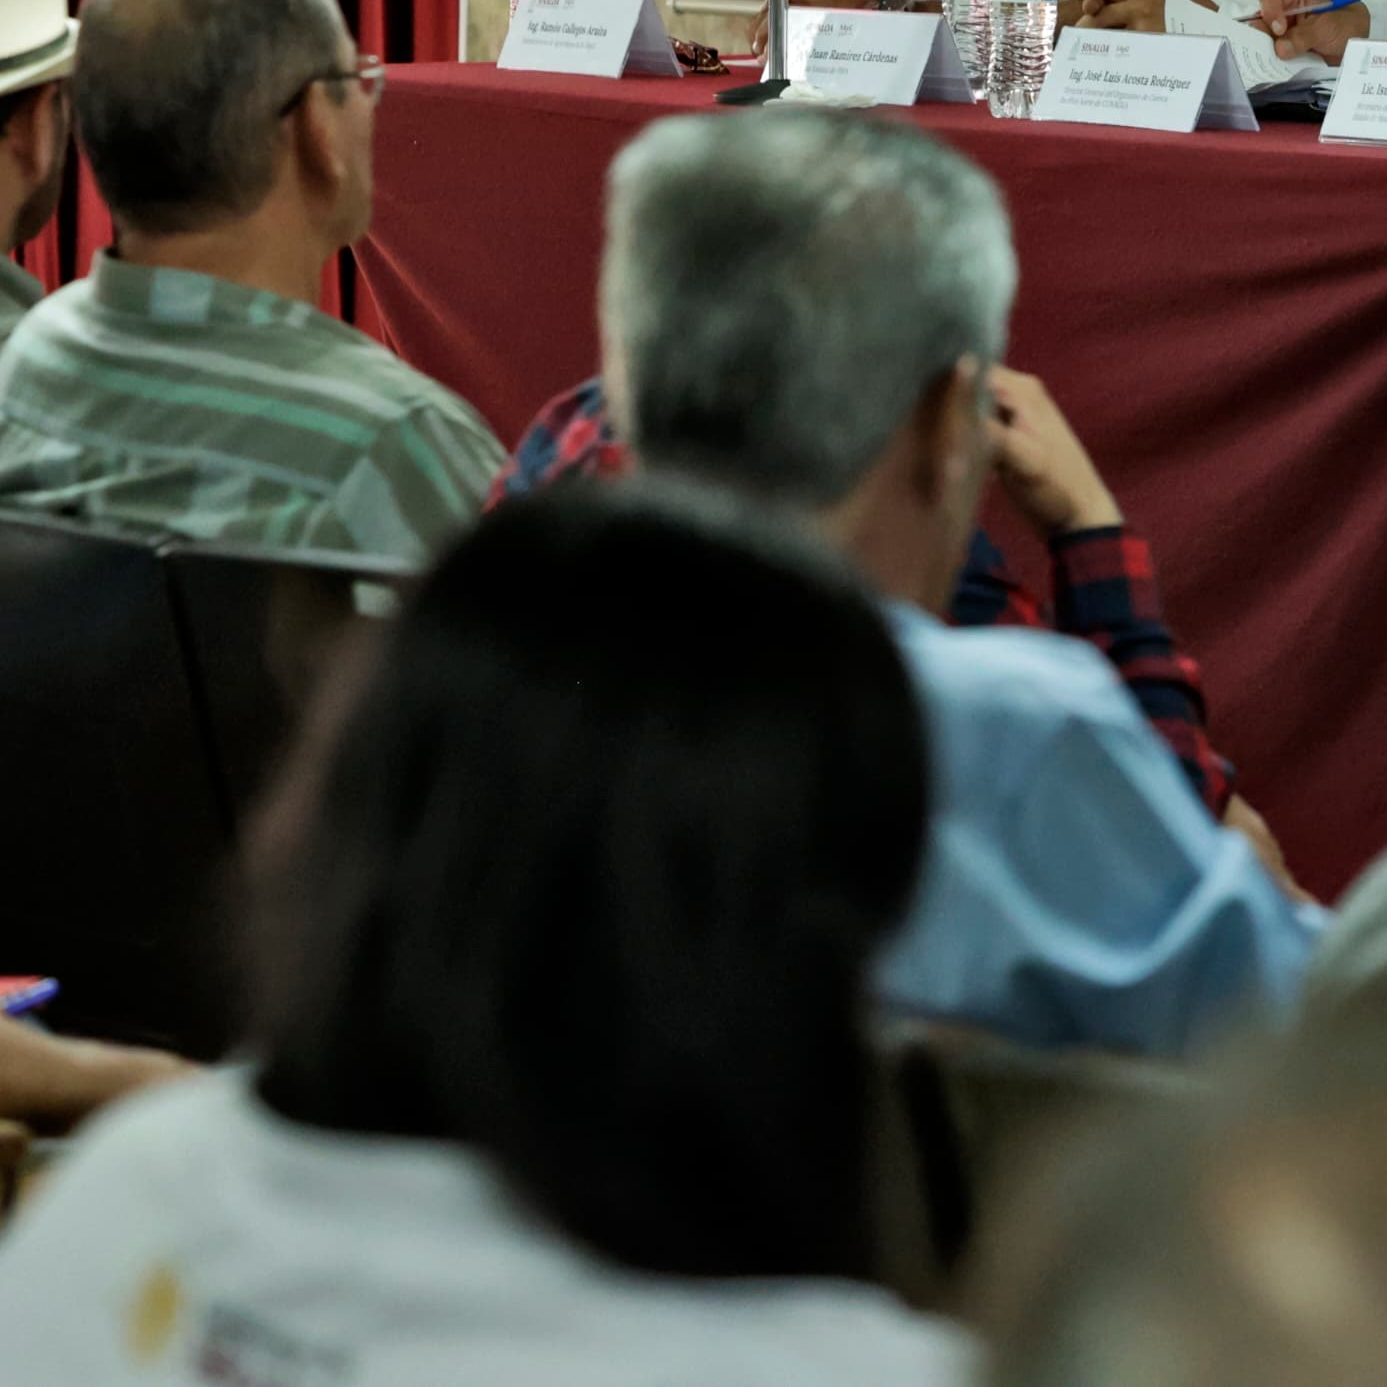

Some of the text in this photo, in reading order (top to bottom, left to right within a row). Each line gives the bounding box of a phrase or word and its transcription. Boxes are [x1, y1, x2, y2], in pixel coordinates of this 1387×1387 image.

[862, 50, 898, 64] Cárdenas
[1084, 69, 1103, 82] José
[1103, 70, 1121, 84] Luis
[1123, 73, 1149, 86] Acosta
[1149, 75, 1192, 91] Rodríguez
